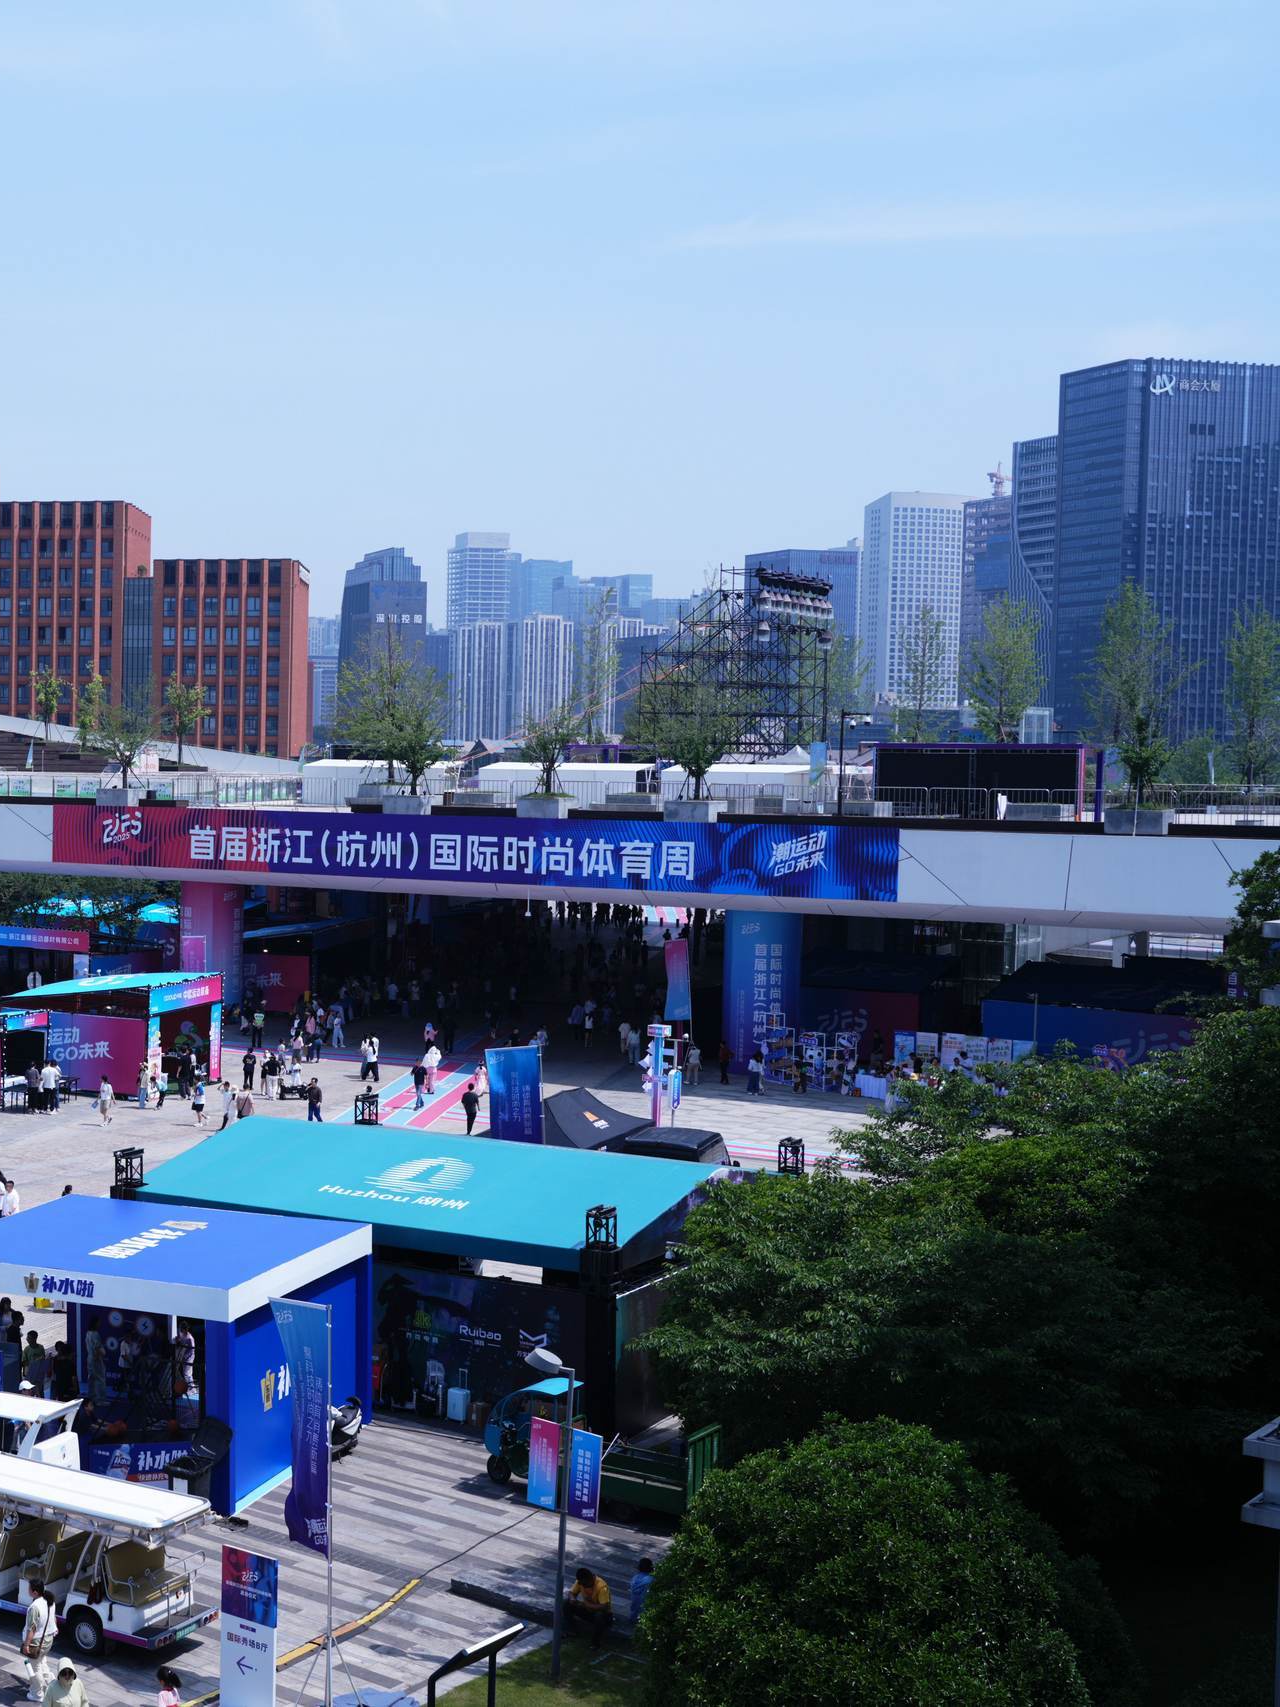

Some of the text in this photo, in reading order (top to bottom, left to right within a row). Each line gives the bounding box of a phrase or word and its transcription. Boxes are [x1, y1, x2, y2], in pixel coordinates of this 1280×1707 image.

[113, 831, 131, 845] 2025
[769, 830, 828, 869] 潮运动
[189, 825, 696, 881] 首届浙江（杭州）国际时尚体育周
[775, 850, 829, 878] GO未来
[53, 1040, 115, 1062] GO未来
[318, 1183, 470, 1210] Huzhou 湖州
[42, 1273, 95, 1299] 补水啦
[459, 1324, 502, 1342] Ruibao
[226, 1631, 269, 1653] 国际秀场B厅
